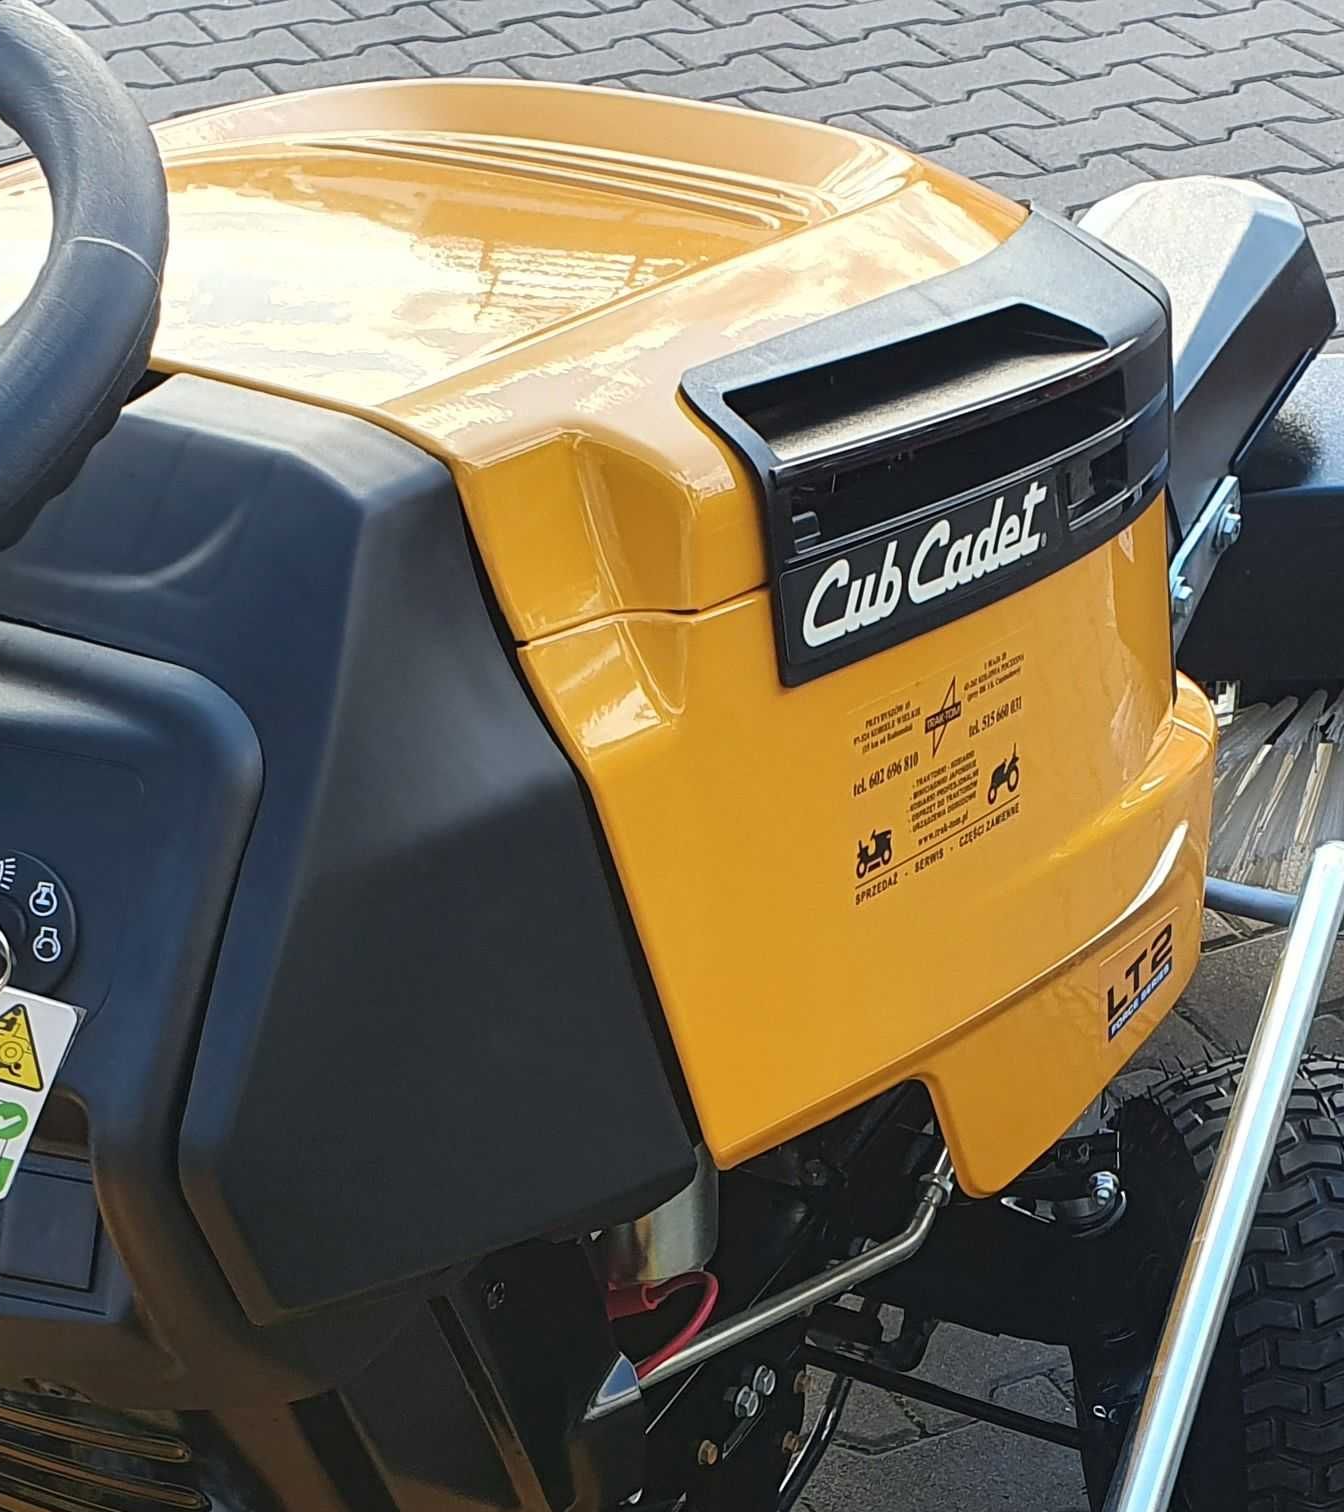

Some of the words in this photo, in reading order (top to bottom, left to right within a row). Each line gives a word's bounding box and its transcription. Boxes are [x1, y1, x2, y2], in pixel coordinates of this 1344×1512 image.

[803, 540, 902, 648] Cub
[908, 481, 1047, 604] Cadet
[853, 776, 867, 797] tel.
[869, 767, 885, 788] 602
[887, 760, 902, 780] 696
[904, 752, 919, 771] 810
[914, 848, 944, 873] SERWIS
[1107, 923, 1172, 1022] LT2
